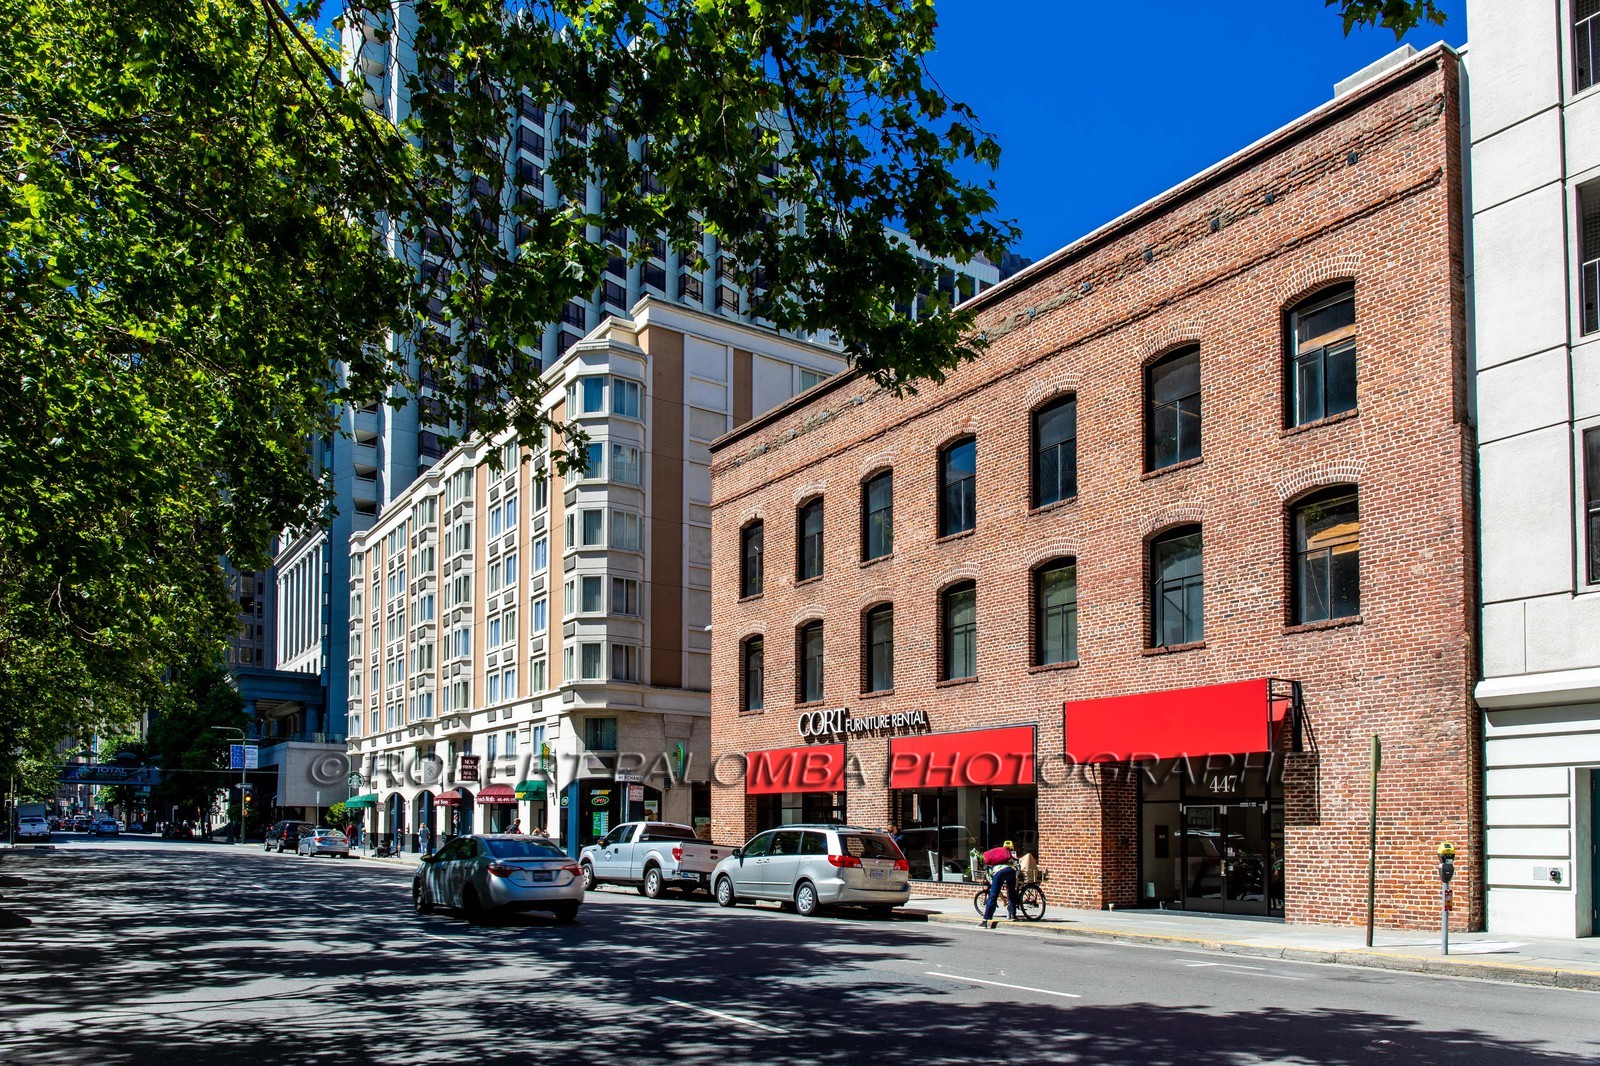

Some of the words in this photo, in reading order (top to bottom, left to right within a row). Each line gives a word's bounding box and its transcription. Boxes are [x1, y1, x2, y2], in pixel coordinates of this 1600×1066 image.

[798, 708, 845, 737] CORT
[845, 715, 890, 732] FURNITURE
[891, 710, 926, 728] RENTAL
[96, 766, 128, 774] TOTAL
[1209, 775, 1238, 792] 447
